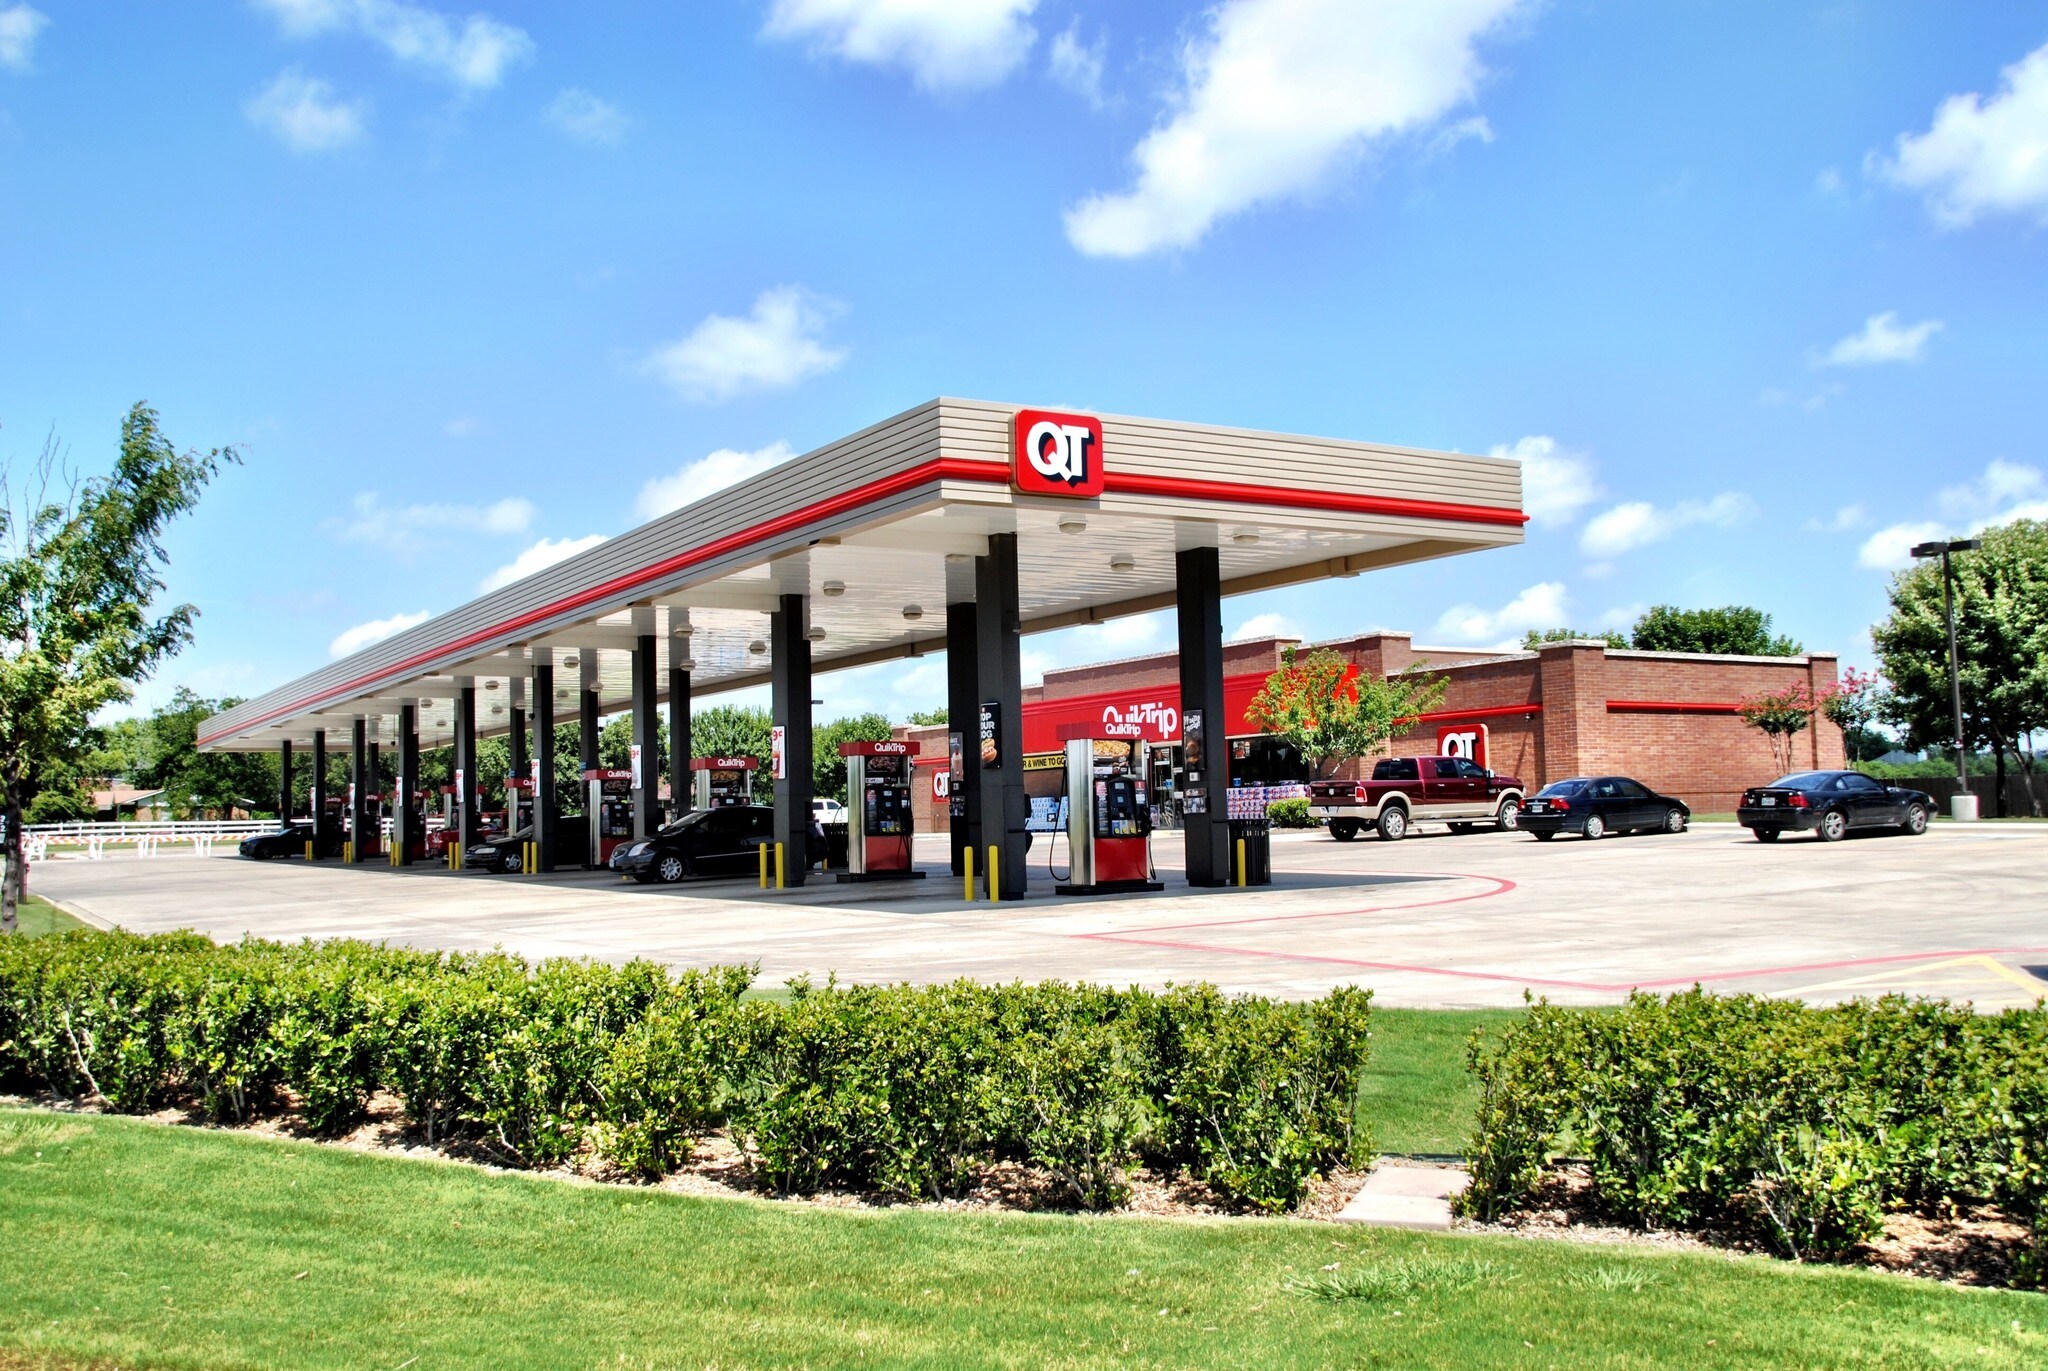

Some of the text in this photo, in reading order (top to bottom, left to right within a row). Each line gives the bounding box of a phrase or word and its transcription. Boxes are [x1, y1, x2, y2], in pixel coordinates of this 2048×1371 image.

[1026, 420, 1092, 485] QT
[1103, 702, 1177, 739] QuikTrip
[1105, 723, 1141, 737] QuikTrip
[874, 742, 906, 754] QuikTrip
[1442, 732, 1476, 760] QT
[717, 758, 746, 768] QuikTrip
[1032, 758, 1047, 767] WINE
[1048, 757, 1056, 766] TO
[607, 770, 632, 779] QuikTrip
[934, 772, 949, 798] QT
